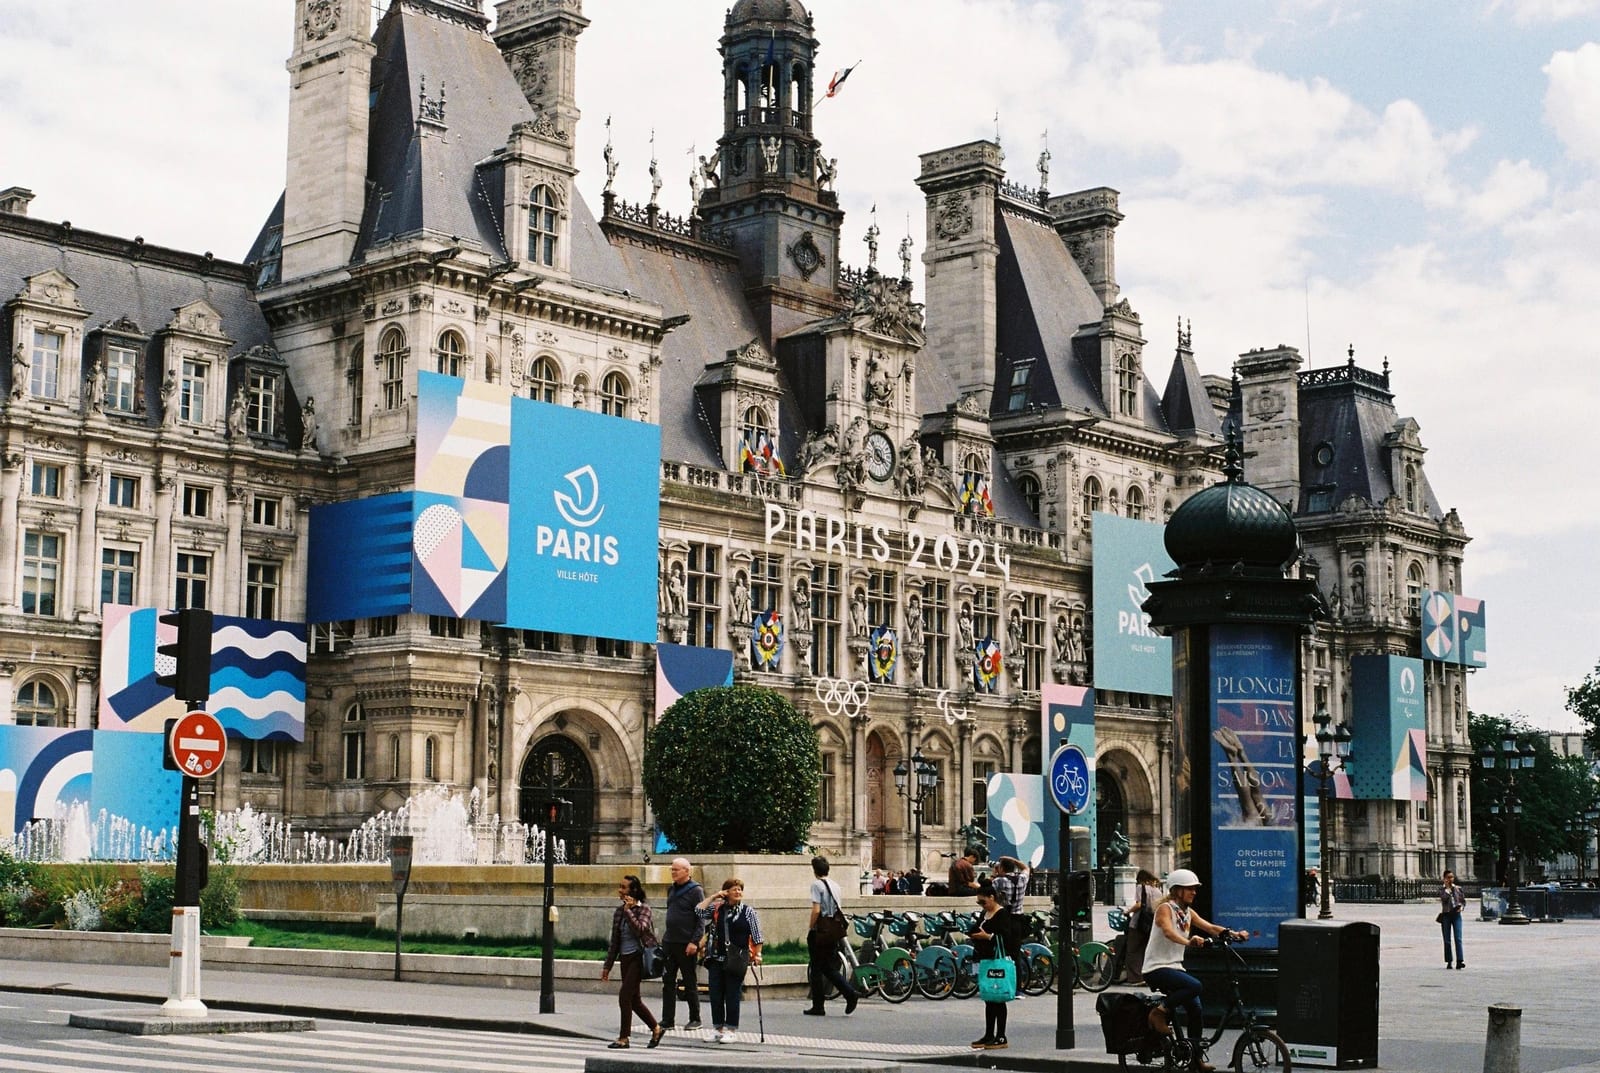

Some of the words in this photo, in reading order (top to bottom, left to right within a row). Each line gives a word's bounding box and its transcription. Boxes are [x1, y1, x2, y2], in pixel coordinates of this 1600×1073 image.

[536, 525, 619, 566] PARIS
[765, 503, 890, 562] PARIS
[908, 528, 1010, 582] 2024
[557, 569, 577, 580] VILLE
[578, 571, 599, 584] HÔTE
[1217, 677, 1293, 695] PLONGEZ
[1255, 708, 1294, 727] DANS
[1278, 740, 1295, 758] LA
[1217, 770, 1285, 788] SAISON
[1237, 849, 1285, 858] ORCHESTRE
[1234, 860, 1247, 868] DE
[1249, 860, 1287, 868] CHAMBRE
[1244, 870, 1257, 878] DE
[1258, 870, 1281, 878] PARIS
